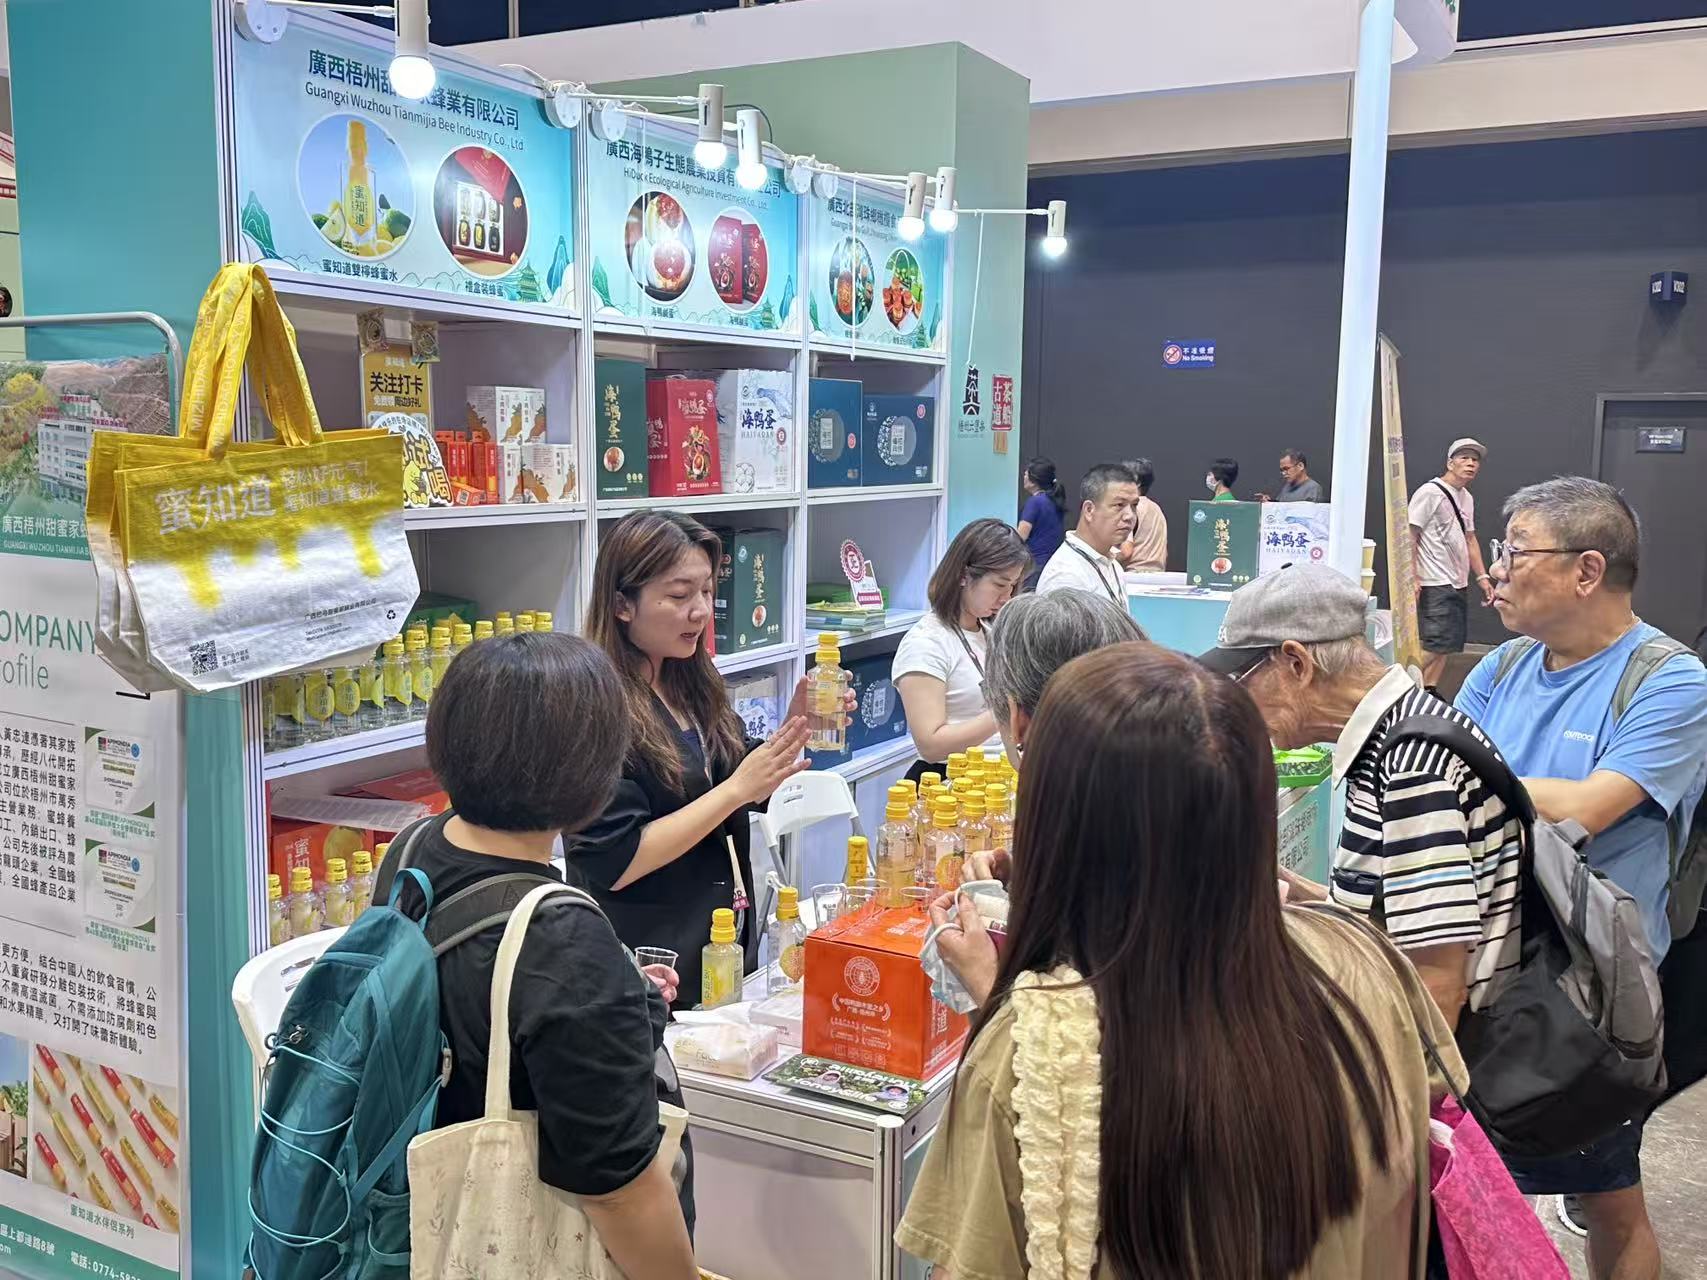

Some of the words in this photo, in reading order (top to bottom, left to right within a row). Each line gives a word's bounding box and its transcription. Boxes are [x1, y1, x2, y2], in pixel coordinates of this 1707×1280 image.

[308, 49, 519, 131] 廣西梧州甜蜂業有限公司
[305, 81, 349, 106] Guangxi
[351, 93, 391, 116] Wuzhou
[393, 104, 437, 129] Tianmijia
[438, 117, 456, 133] Bee
[457, 122, 493, 144] Industry
[649, 172, 681, 191] Ecological
[681, 181, 714, 199] Agriculture
[1190, 354, 1214, 362] Smoking
[370, 371, 423, 395] 关注打卡
[741, 408, 776, 430] 海鸭蛋
[155, 474, 276, 535] 蜜知道
[1266, 531, 1311, 548] 海鸭蛋
[0, 610, 97, 654] OMPANY
[0, 652, 49, 690] ofile
[0, 727, 76, 754] 黃忠達憑著其家族
[745, 715, 766, 737] 鸭蛋
[0, 763, 76, 791] 立廣西梧州甜蜜家
[0, 853, 76, 884] 龍頭企業，全國蜂
[0, 870, 76, 903] ，全國蜂產品企業
[0, 960, 157, 1021] 入重資研發分離包裝技術，將蜂蜜與
